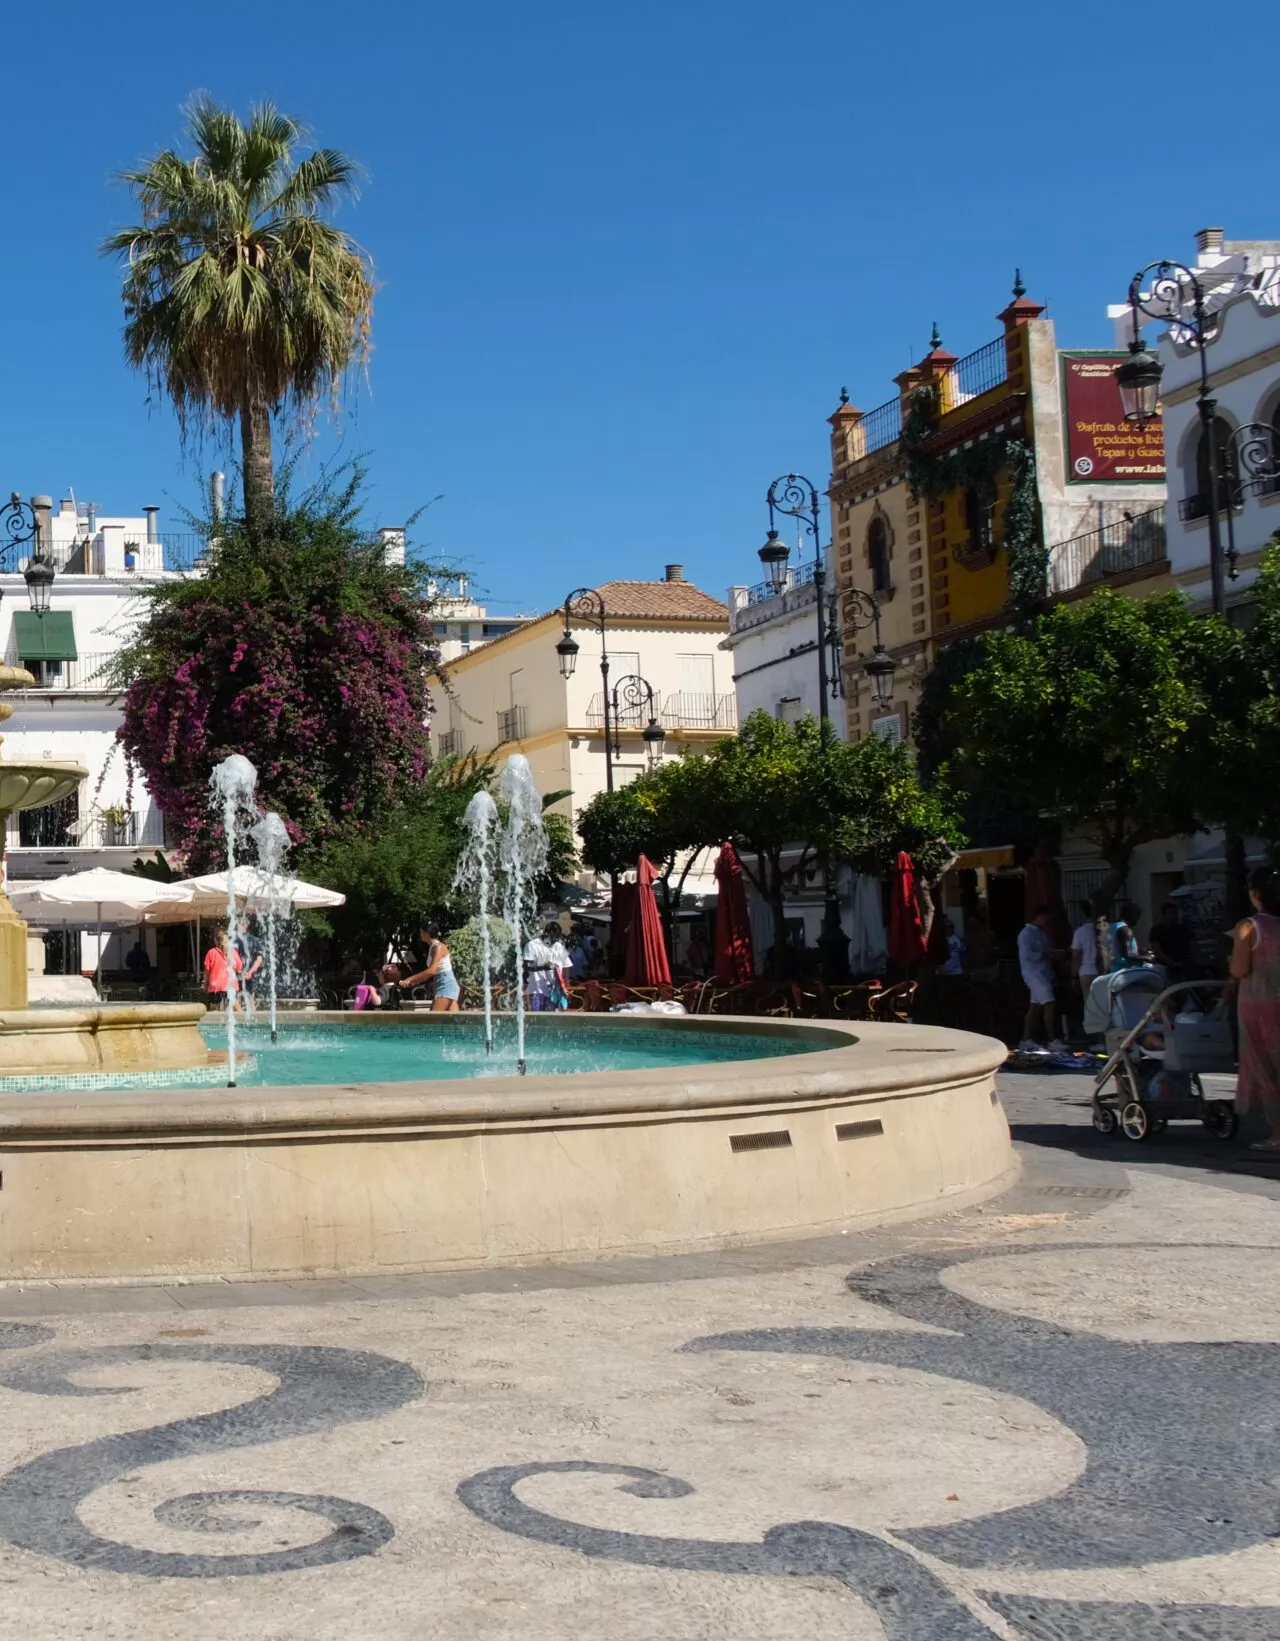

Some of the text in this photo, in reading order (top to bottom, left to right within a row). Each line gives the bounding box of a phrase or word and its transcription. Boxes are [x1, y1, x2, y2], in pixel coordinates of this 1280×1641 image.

[1076, 421, 1116, 434] Disfruta
[1118, 421, 1130, 432] de
[1093, 434, 1144, 447] productos
[1096, 447, 1126, 458] Tapas
[1128, 450, 1135, 459] y
